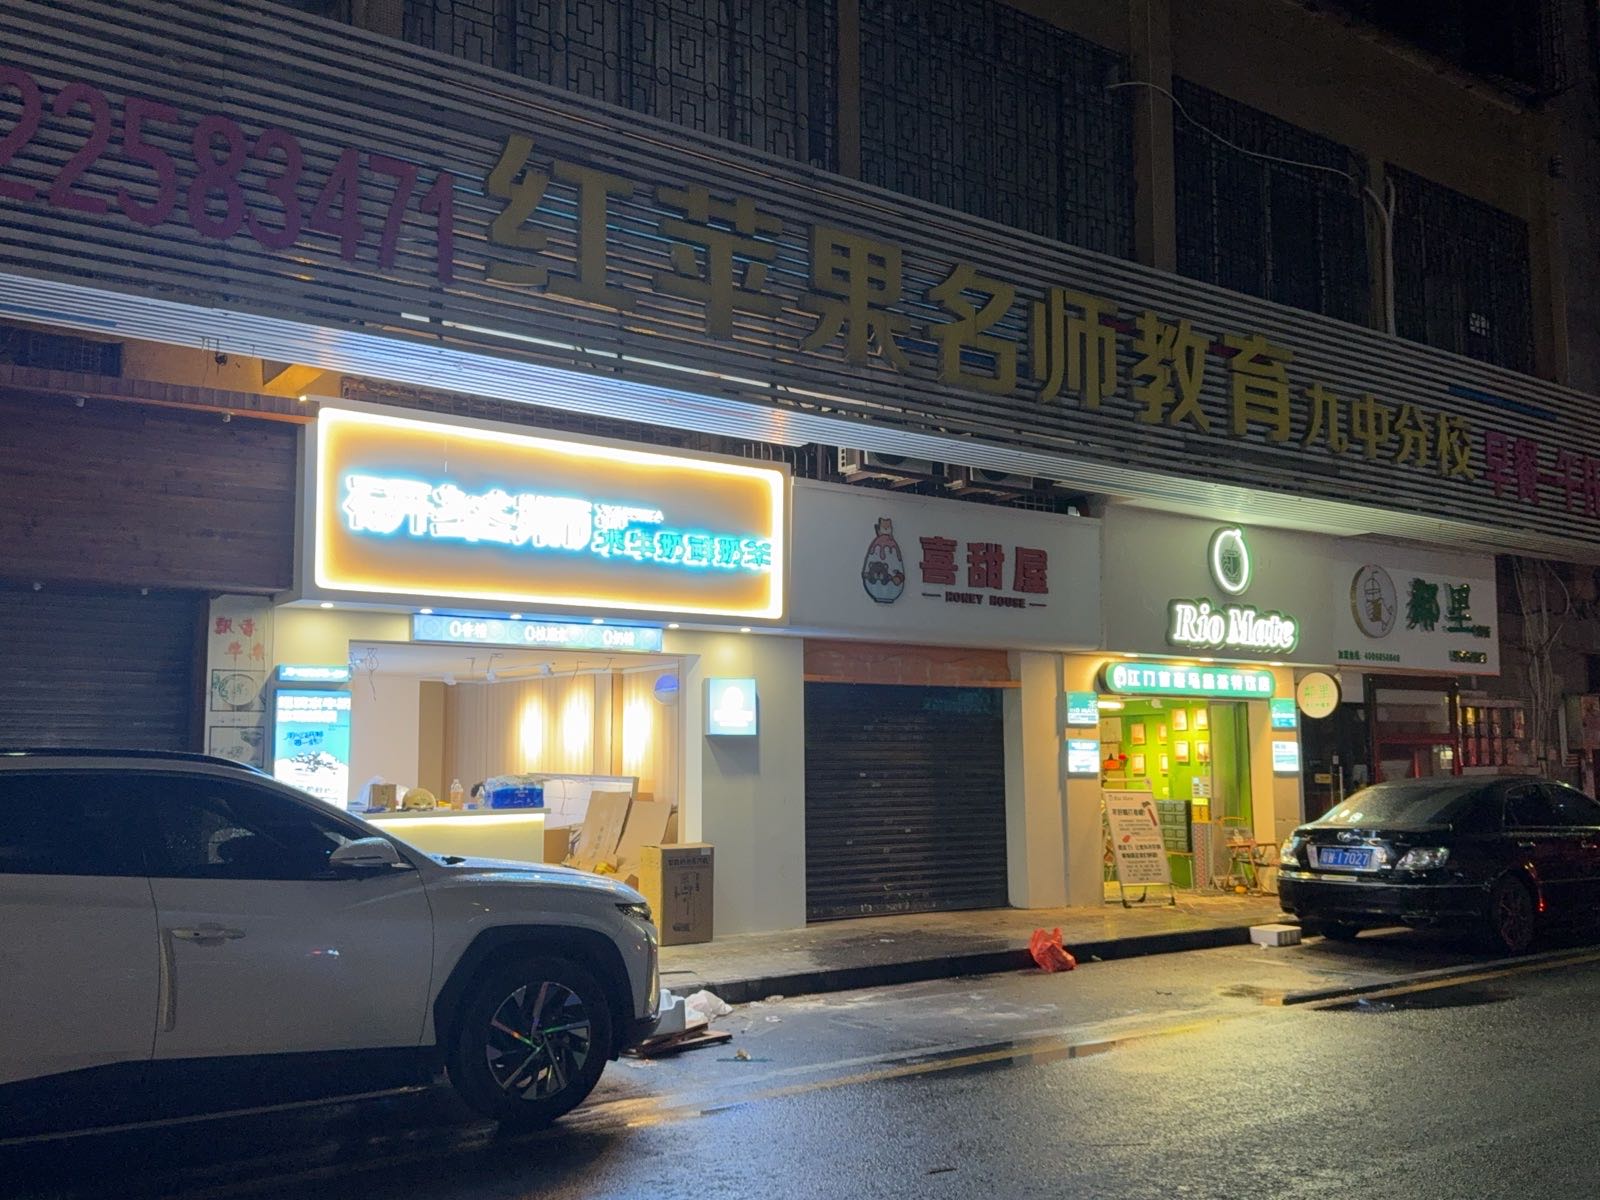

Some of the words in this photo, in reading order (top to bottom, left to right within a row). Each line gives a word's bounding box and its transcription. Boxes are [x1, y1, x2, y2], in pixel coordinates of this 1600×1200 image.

[919, 536, 1049, 594] 喜甜屋
[945, 591, 984, 605] HONEY
[989, 594, 1026, 609] HOUSE
[1174, 603, 1225, 644] Rio
[1226, 608, 1296, 648] Mate
